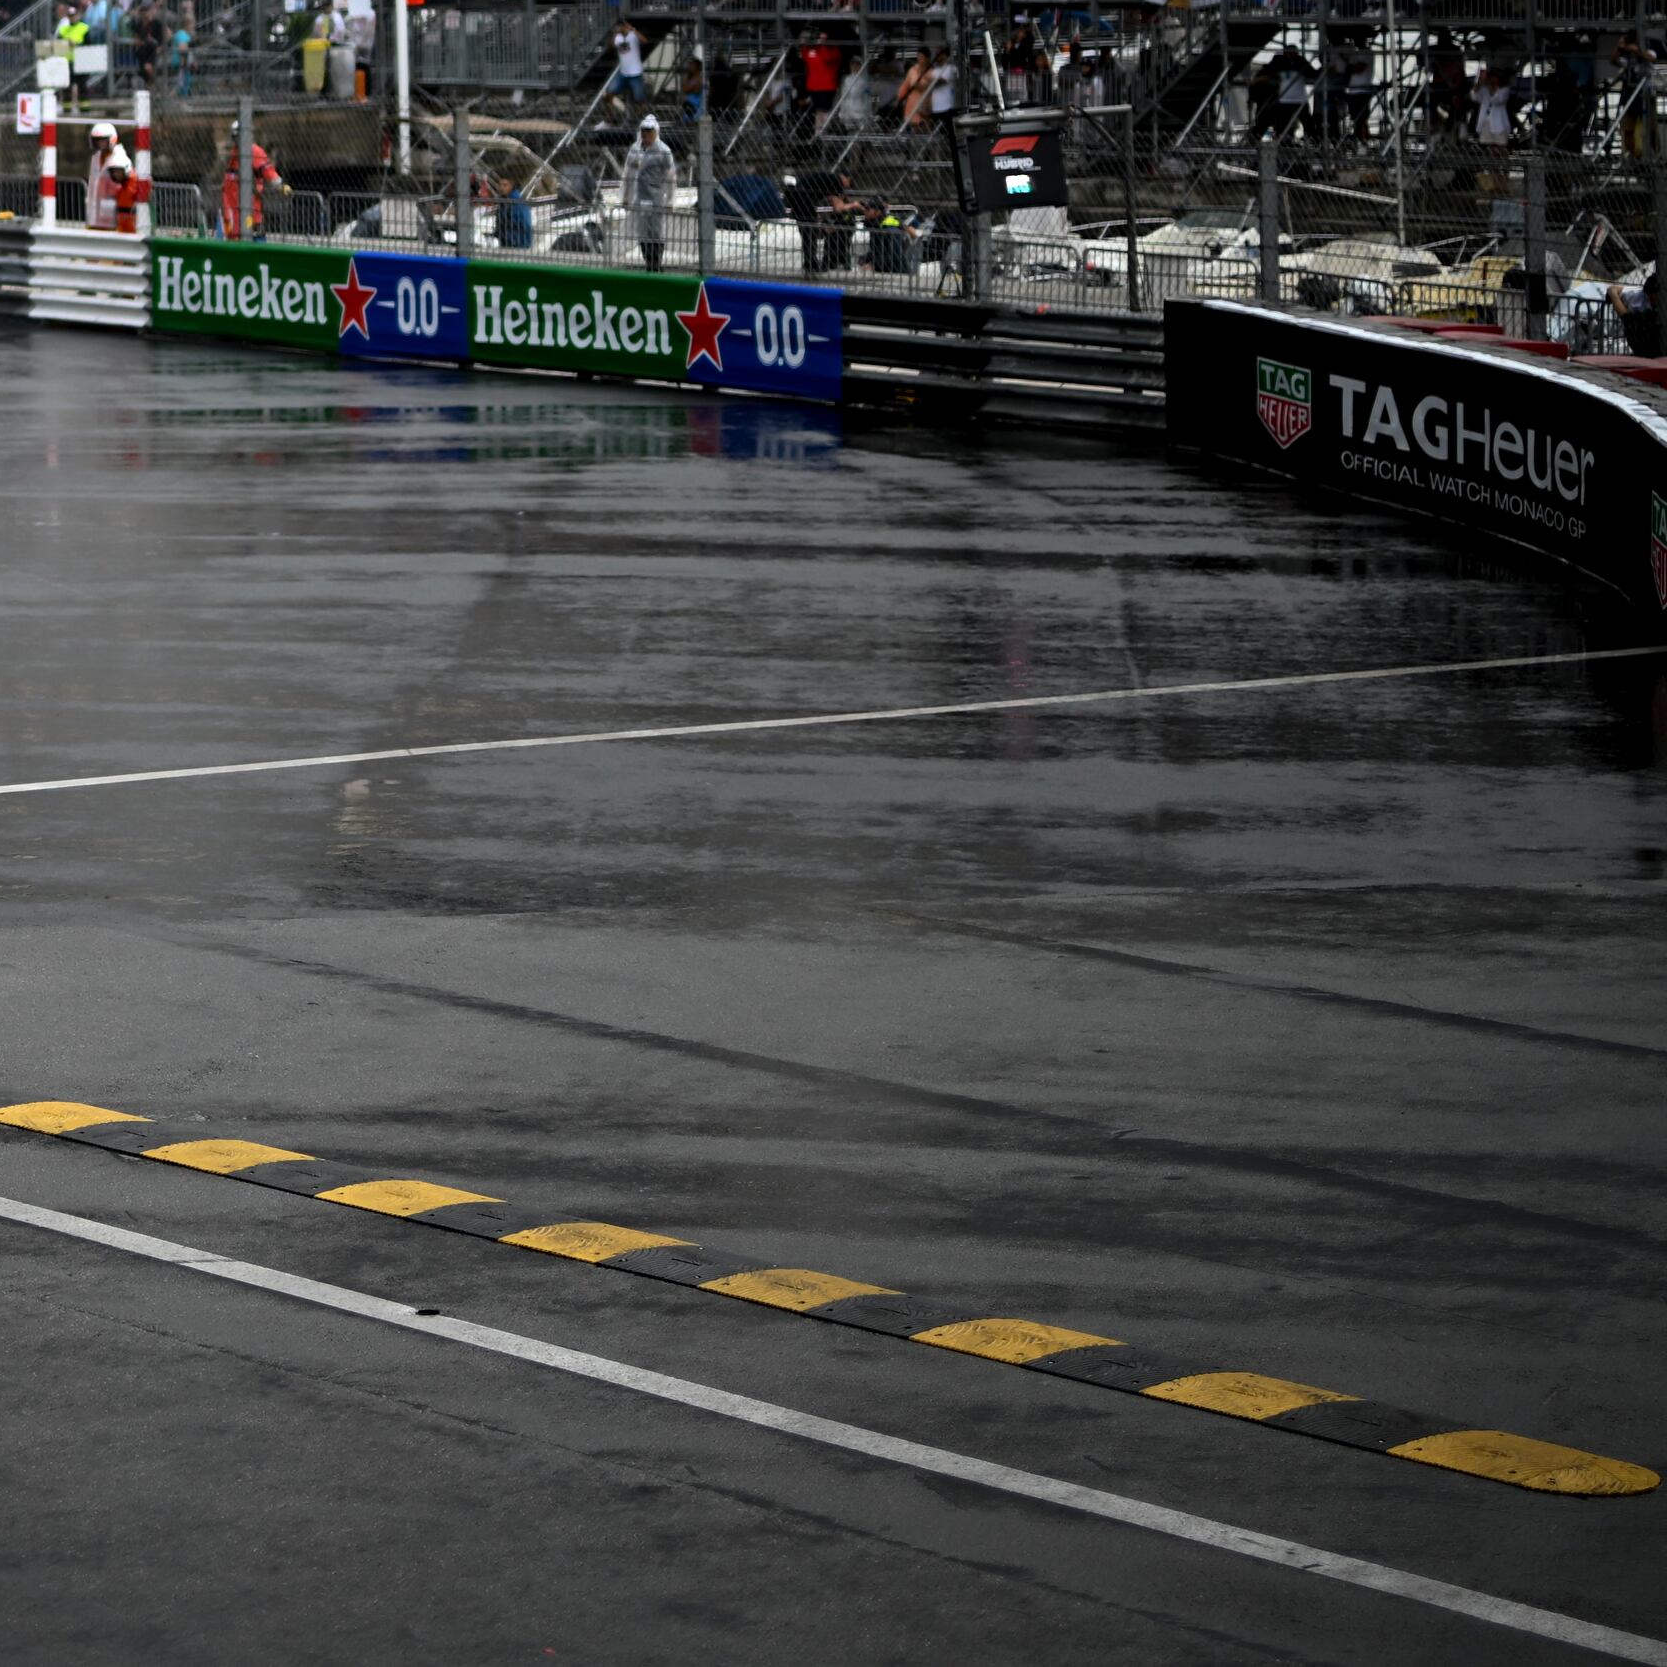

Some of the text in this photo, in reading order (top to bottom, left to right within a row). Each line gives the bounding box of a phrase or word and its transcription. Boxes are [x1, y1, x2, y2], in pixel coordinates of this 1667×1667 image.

[157, 256, 328, 325] Heineken
[473, 285, 672, 355] Heineken
[1261, 362, 1306, 400] TAG
[1258, 396, 1308, 443] HEUER
[1340, 450, 1587, 540] OFFICIAL WATCH MONACO GP
